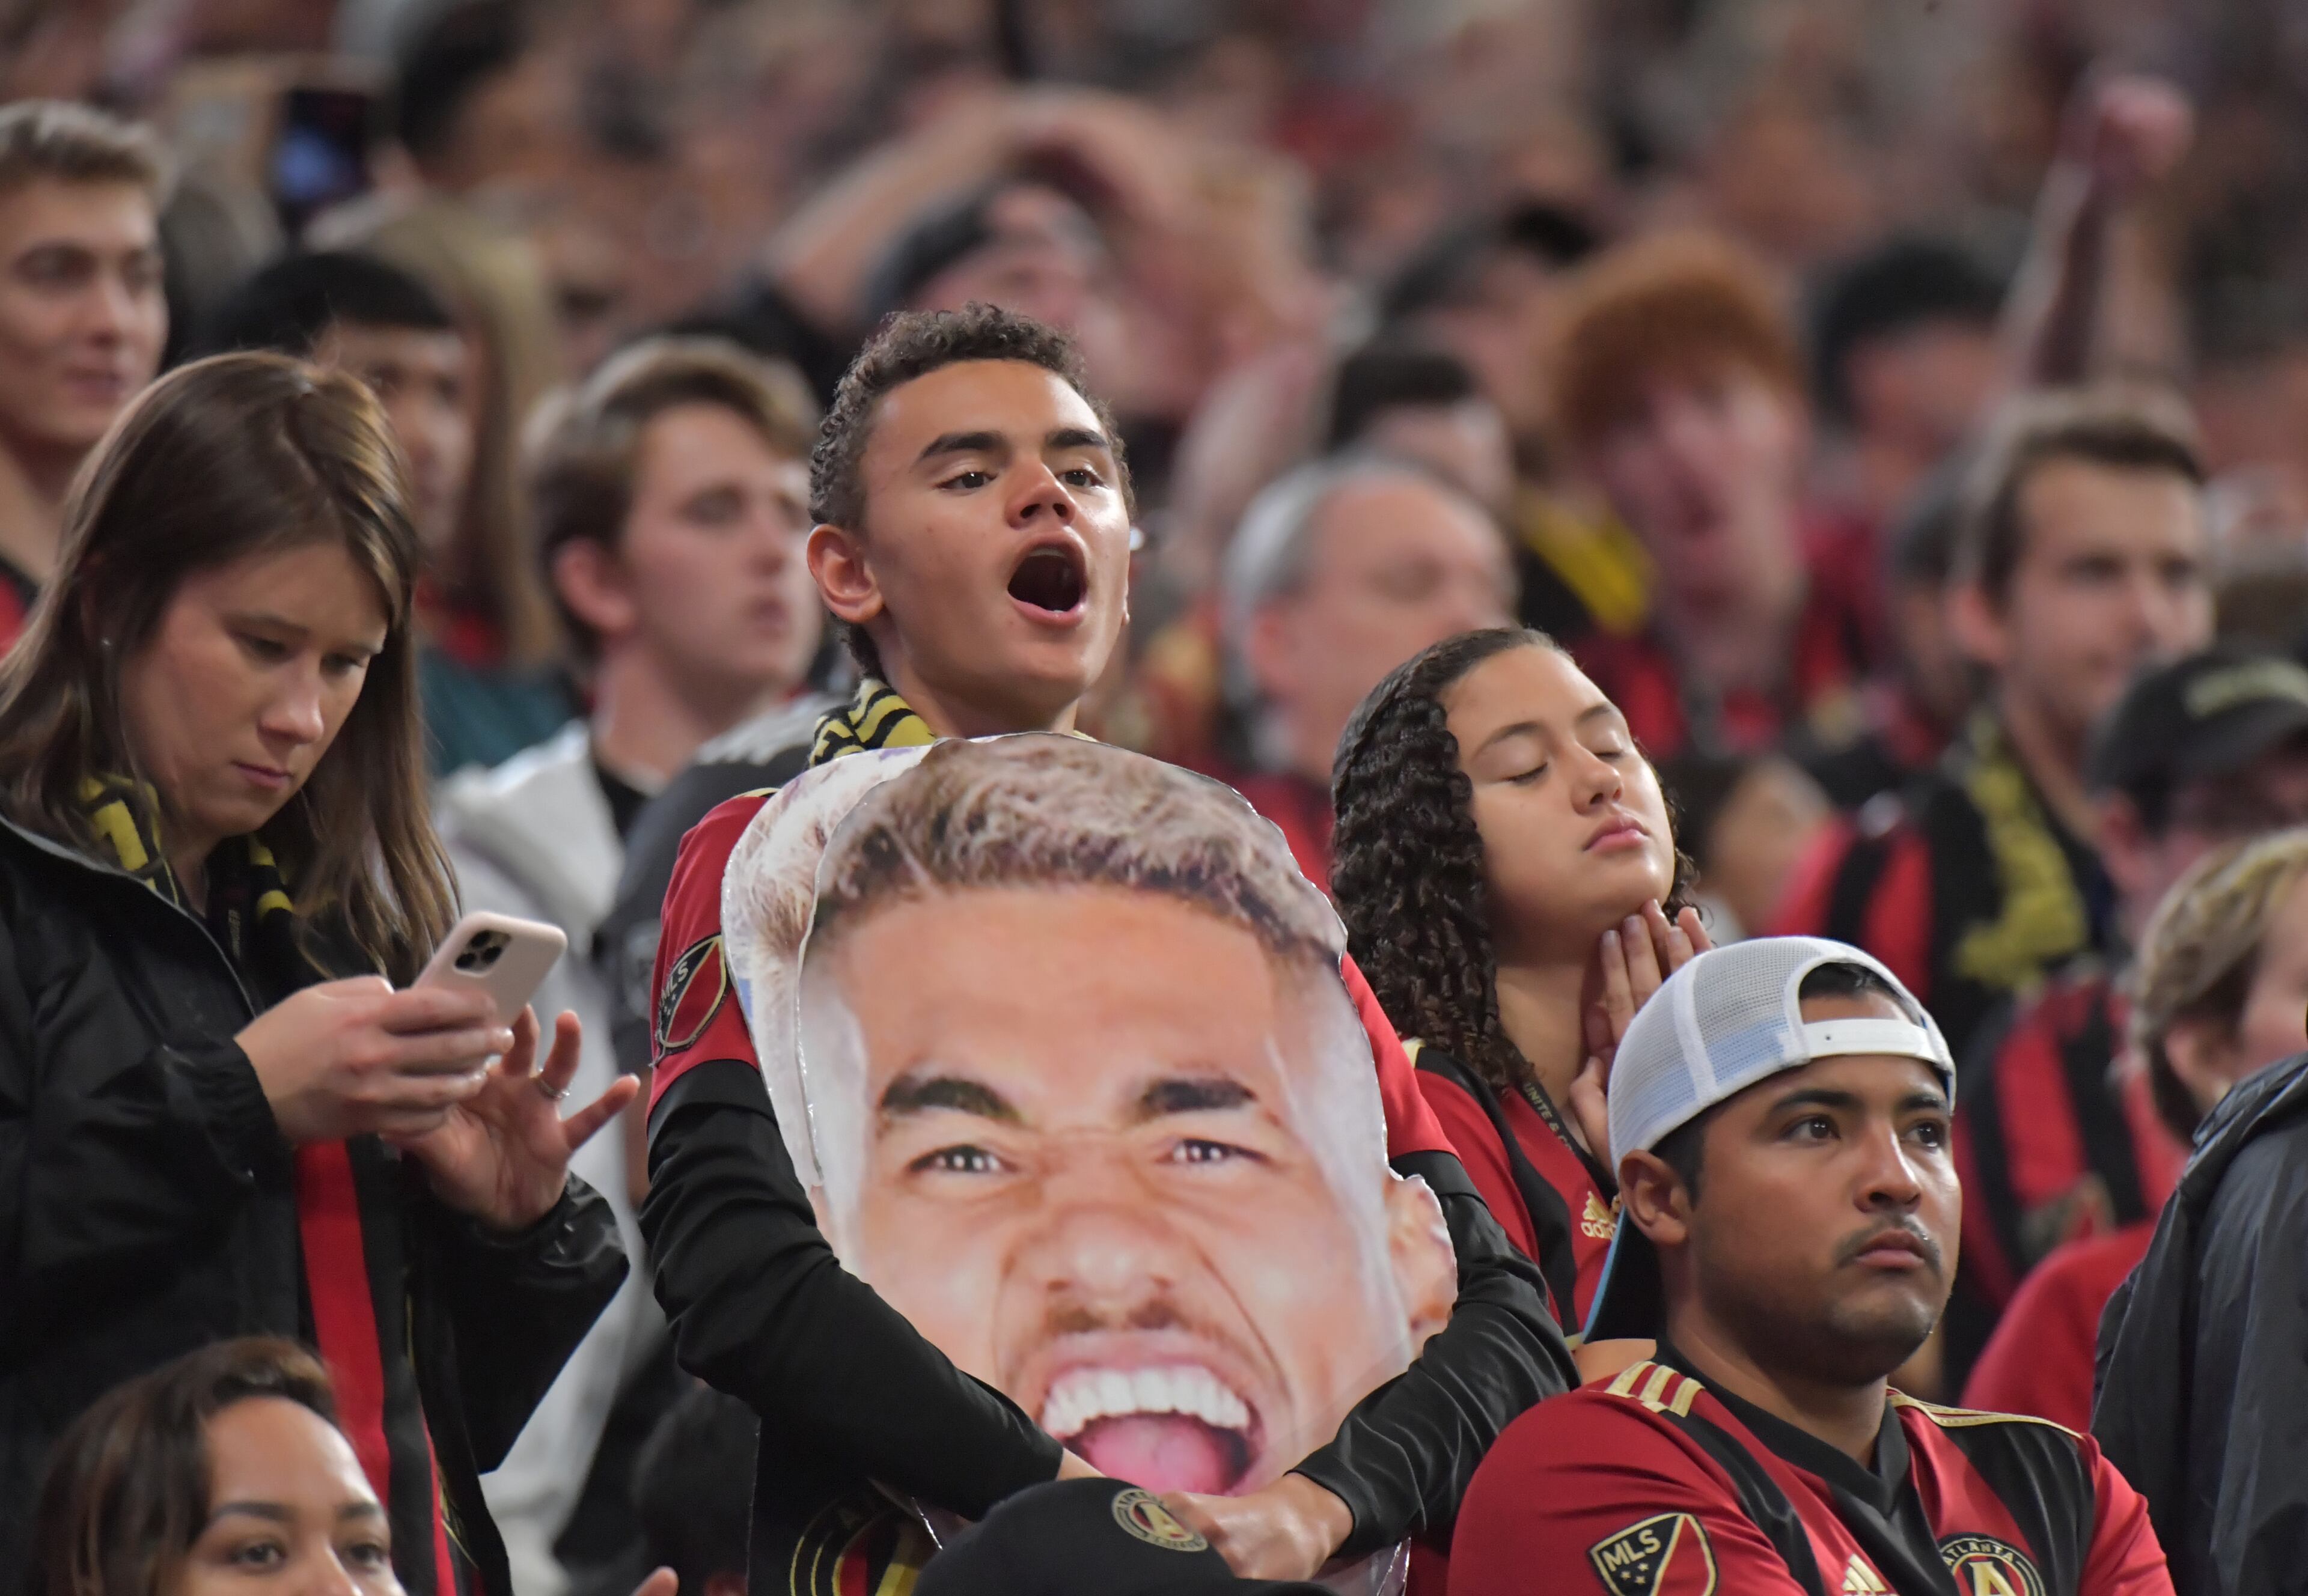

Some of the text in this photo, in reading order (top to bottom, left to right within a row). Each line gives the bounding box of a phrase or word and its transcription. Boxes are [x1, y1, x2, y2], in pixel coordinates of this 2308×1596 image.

[660, 961, 689, 1007] MLS
[1523, 1082, 1552, 1119] UNITE
[1602, 1529, 1661, 1572] MLS
[1943, 1542, 2013, 1566] ATLANTA
